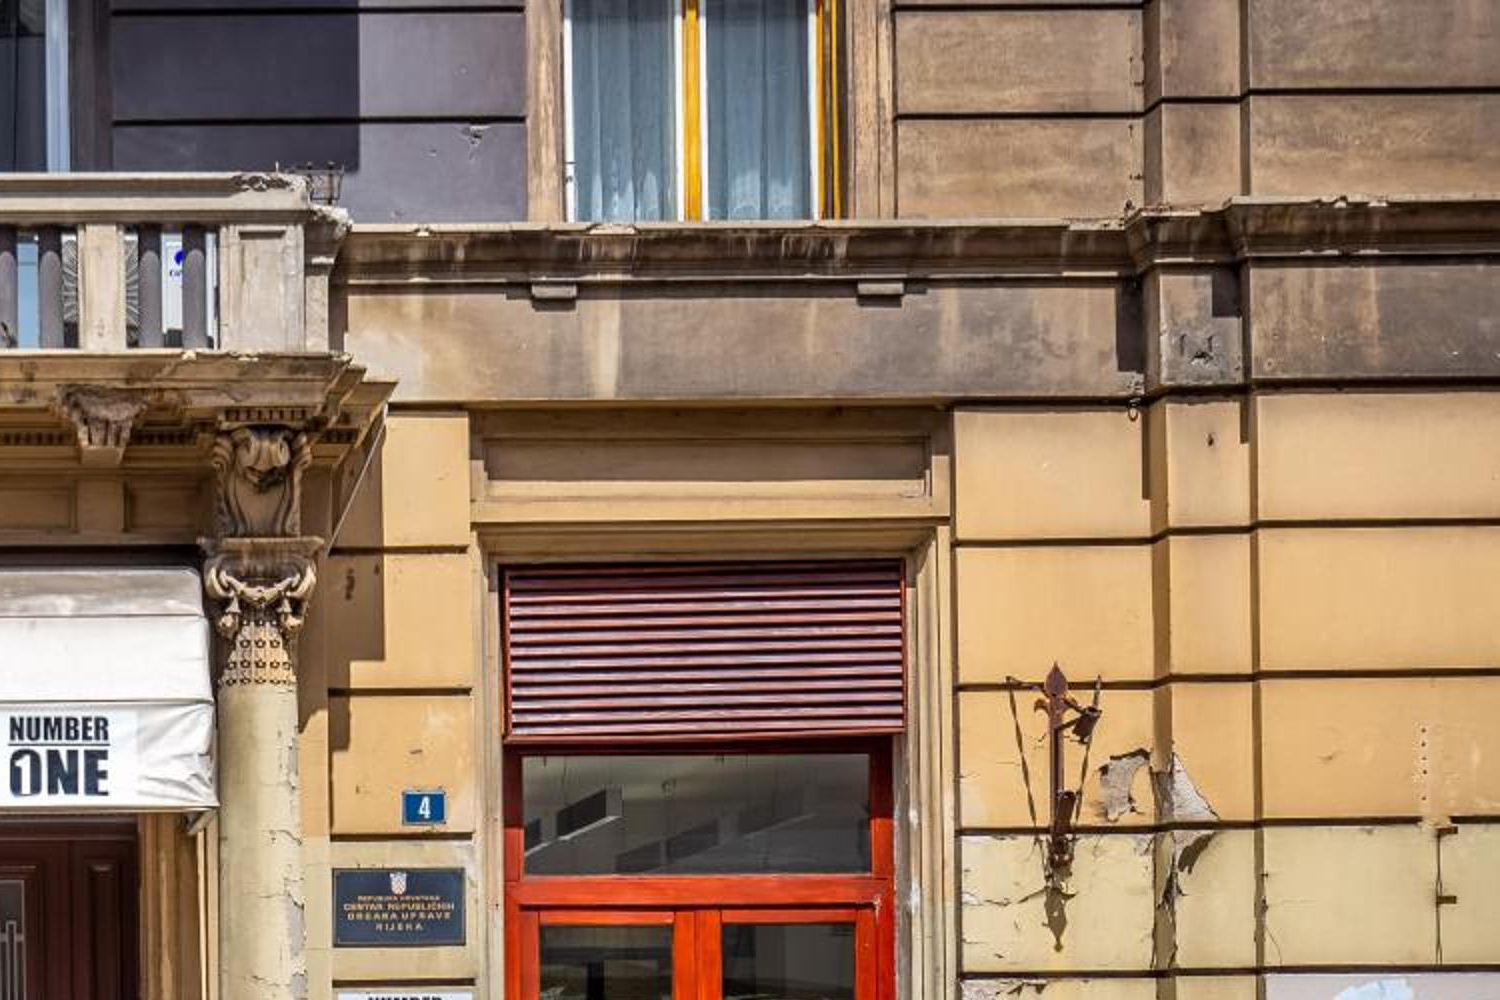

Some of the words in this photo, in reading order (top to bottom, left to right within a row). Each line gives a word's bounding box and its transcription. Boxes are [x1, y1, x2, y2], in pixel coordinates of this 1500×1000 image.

[9, 716, 109, 741] NUMBER
[9, 748, 109, 797] ONE
[418, 796, 431, 819] 4
